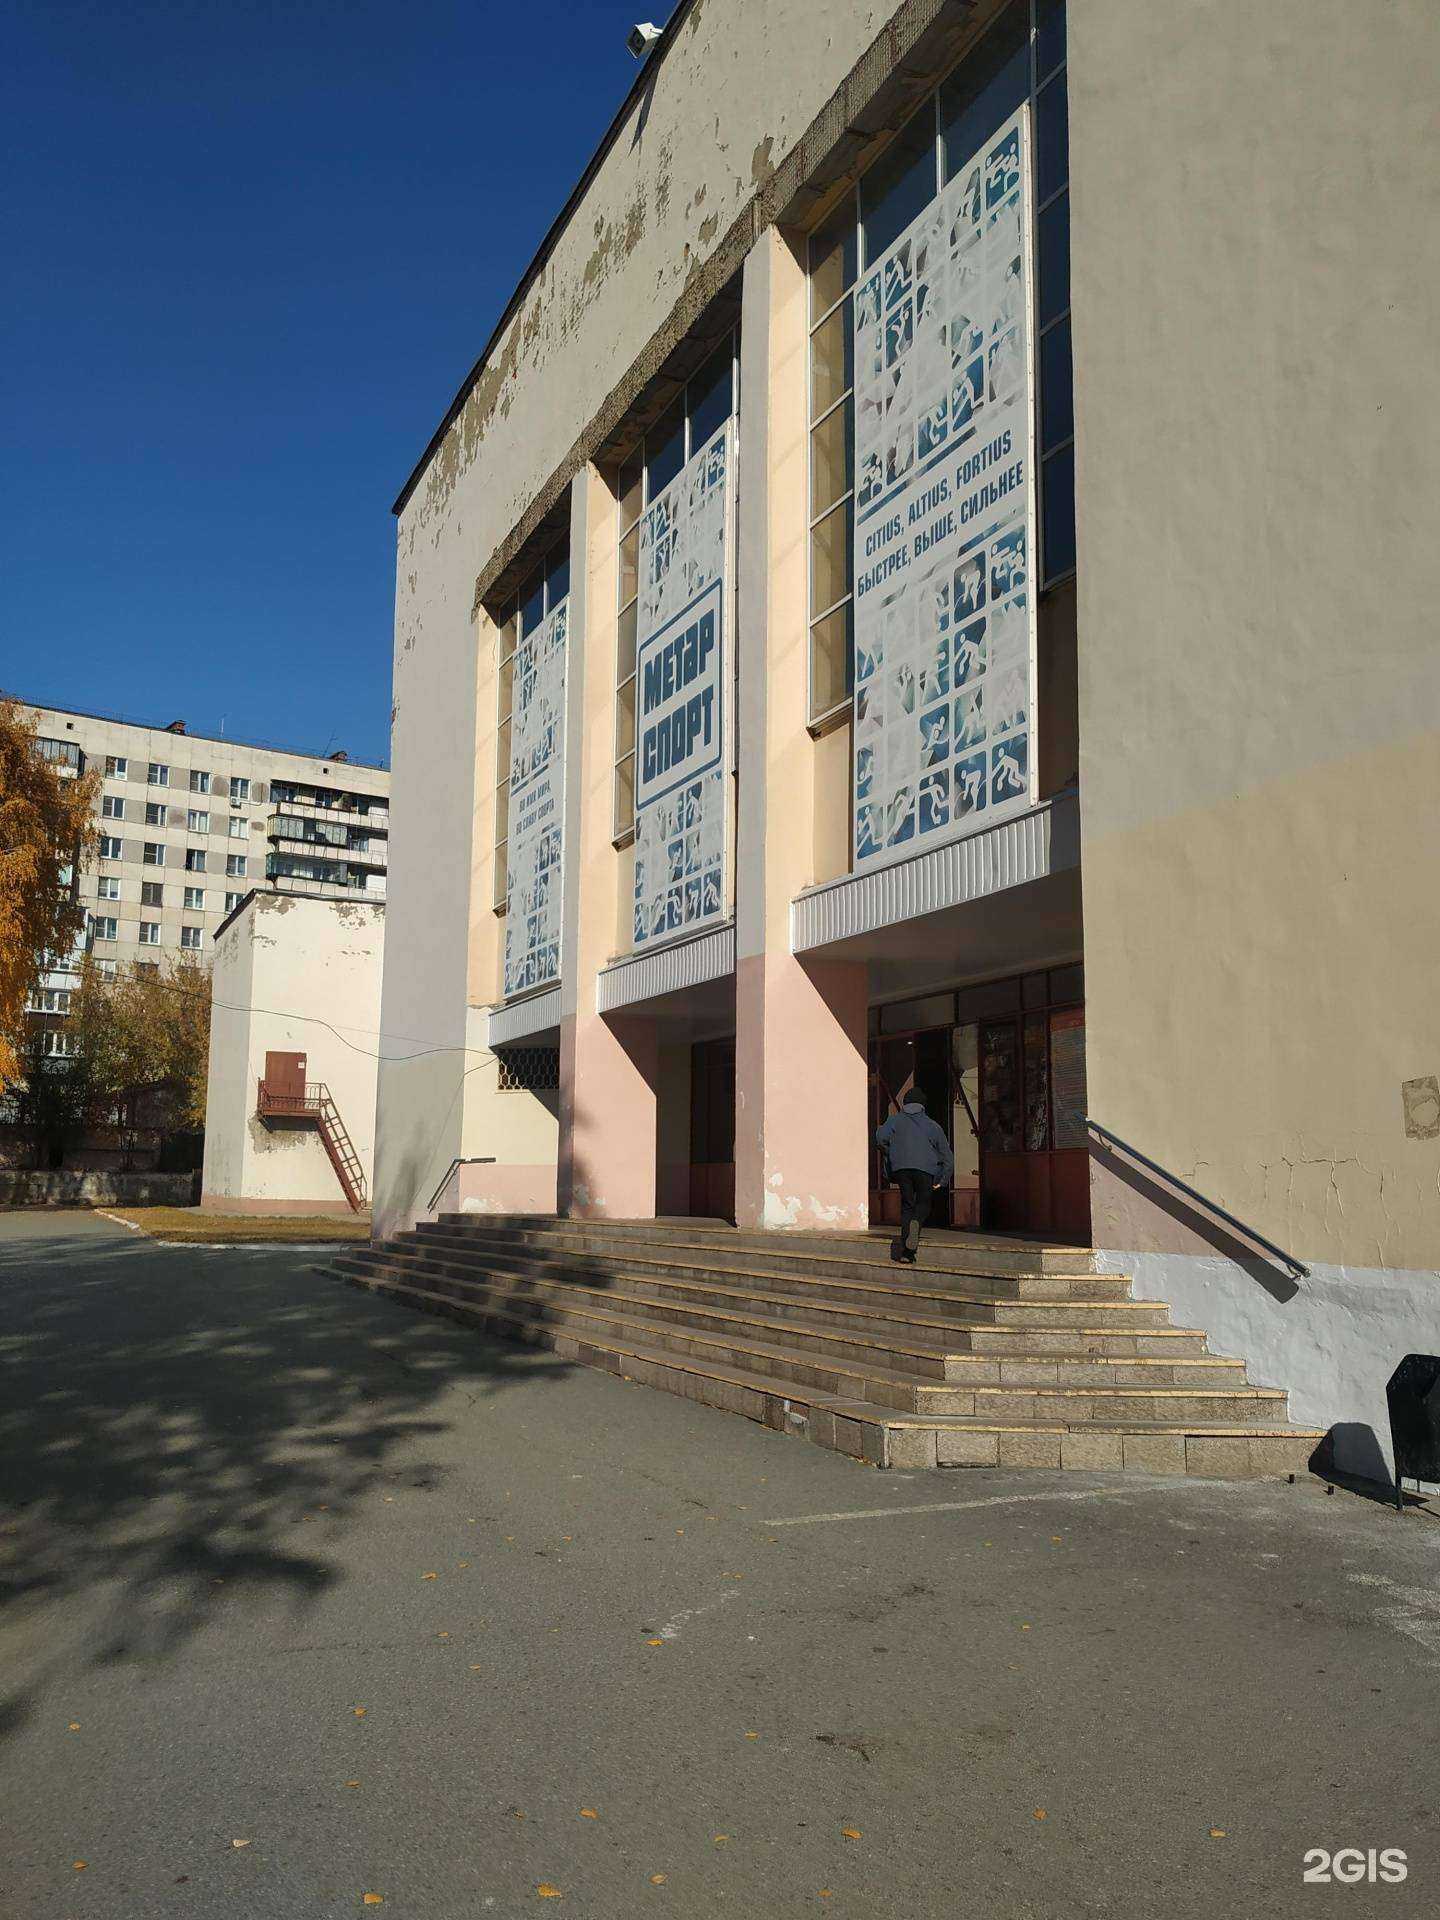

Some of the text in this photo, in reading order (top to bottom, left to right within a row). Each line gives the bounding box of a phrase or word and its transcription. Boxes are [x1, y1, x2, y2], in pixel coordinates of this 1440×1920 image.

[857, 460, 1024, 599] БЫСТРЕЕ, ВЫШЕ, СИЛЬНЕЕ
[865, 429, 1012, 557] CITIUS, ALTIUS, FORTIUS
[642, 684, 714, 785] СПОРТ
